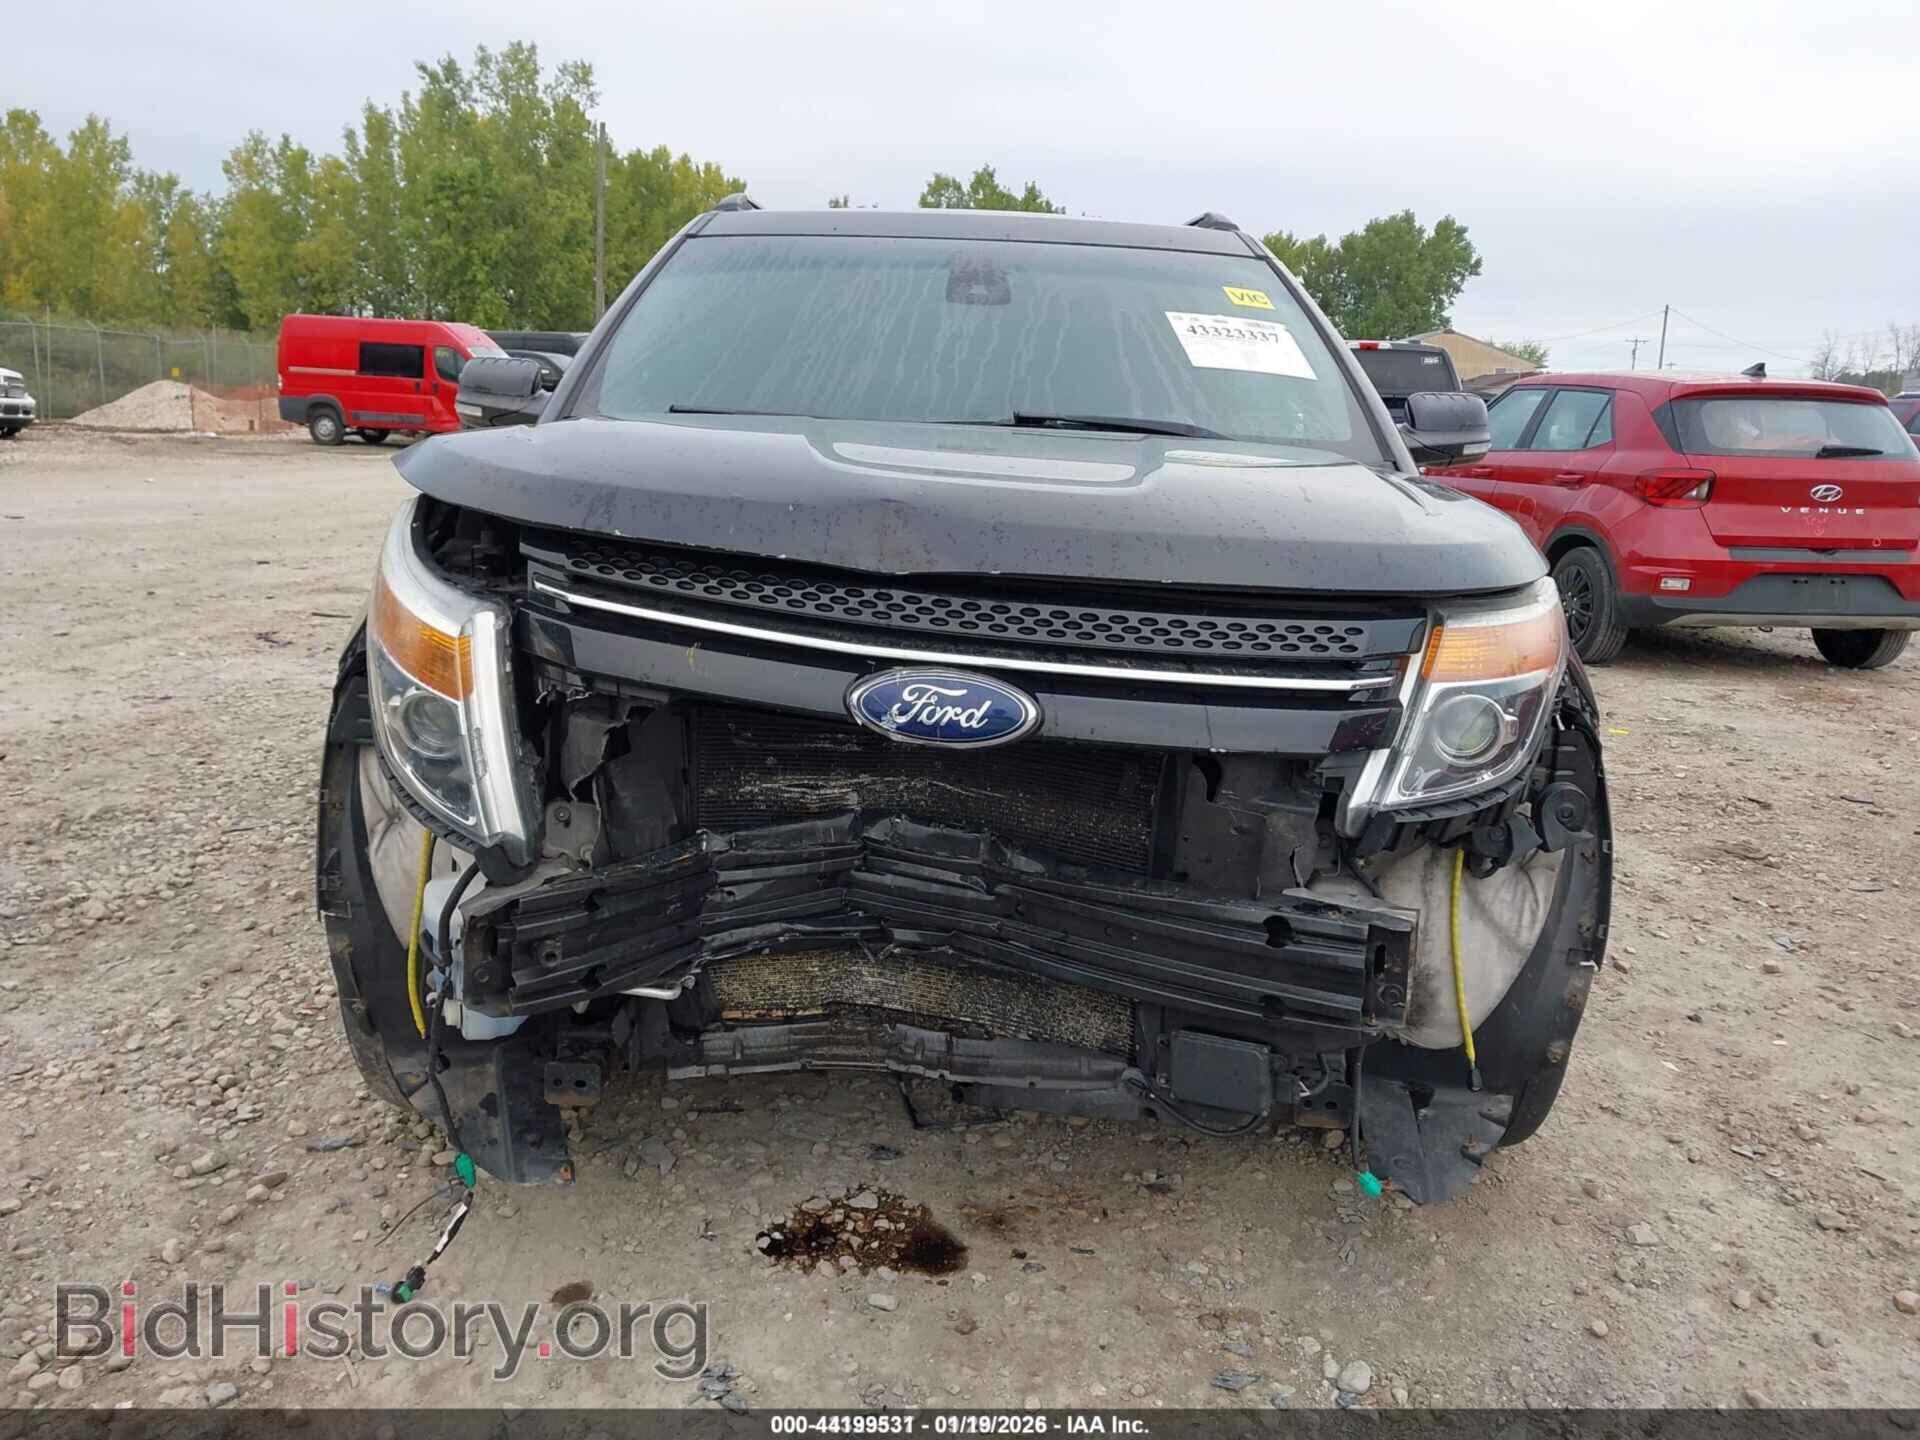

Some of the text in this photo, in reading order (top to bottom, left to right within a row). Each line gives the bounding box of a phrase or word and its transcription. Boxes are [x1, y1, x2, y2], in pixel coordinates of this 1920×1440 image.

[1230, 290, 1268, 305] VIC
[1186, 324, 1279, 344] 43323337
[1780, 506, 1865, 515] VENUE
[891, 684, 992, 728] Ford
